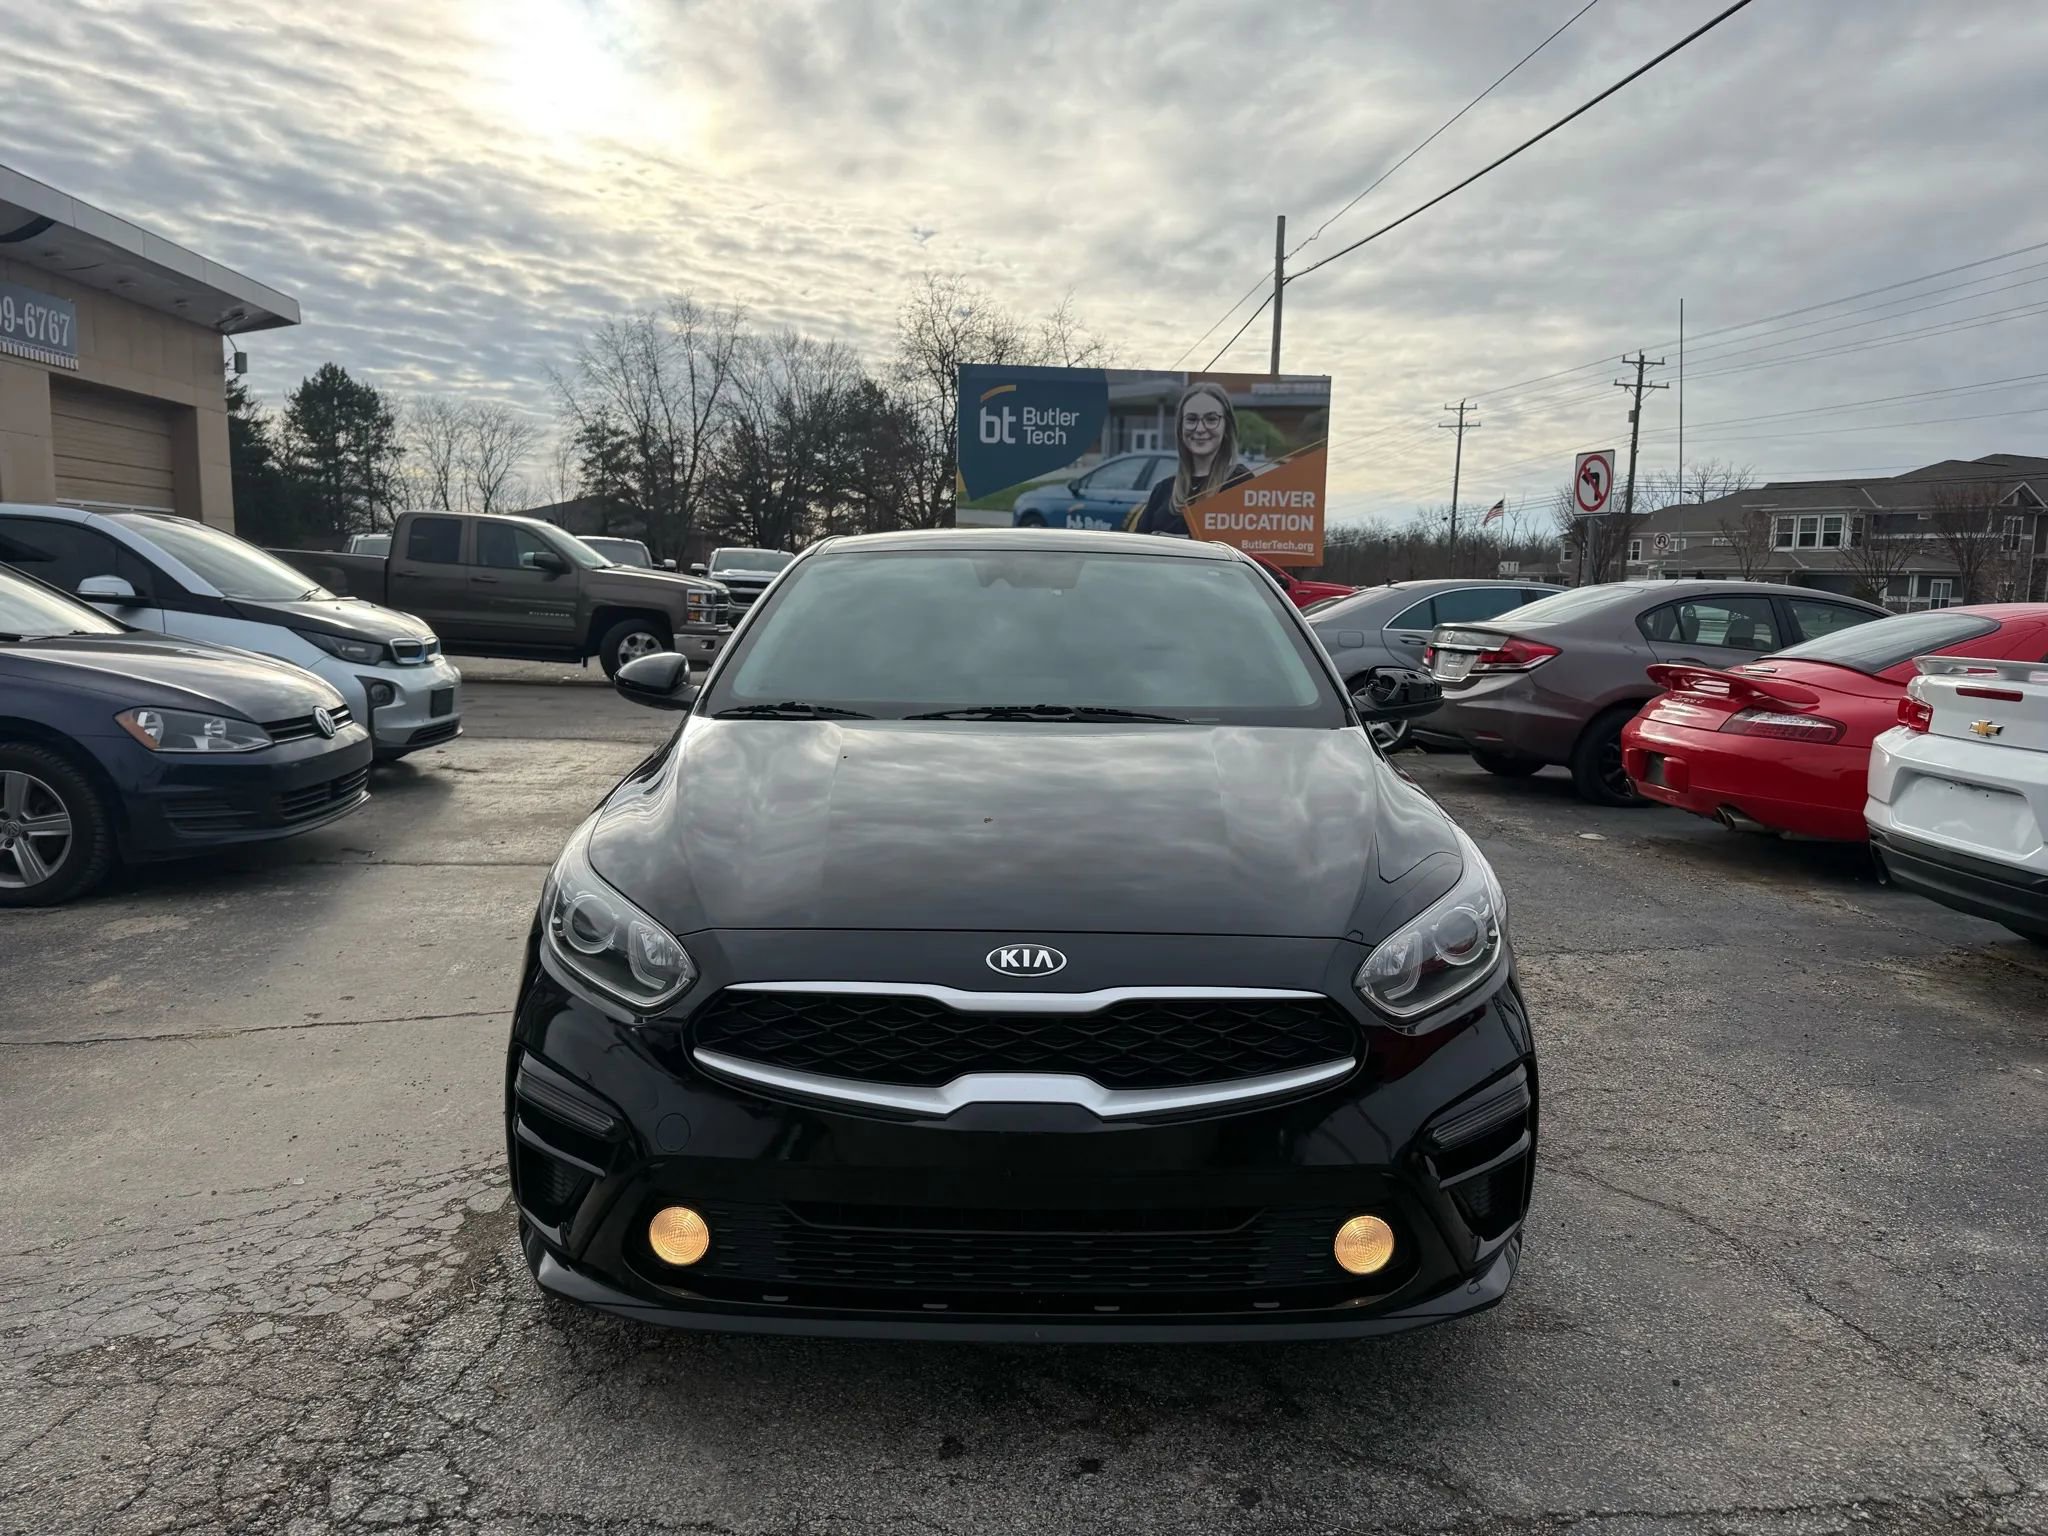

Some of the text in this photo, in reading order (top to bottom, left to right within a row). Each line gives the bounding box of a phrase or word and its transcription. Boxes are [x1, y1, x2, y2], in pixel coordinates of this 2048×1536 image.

[0, 295, 71, 347] 9-6767
[980, 406, 1017, 444] bt
[1023, 406, 1080, 426] Butler
[1022, 426, 1067, 445] Tech
[1243, 489, 1316, 508] DRIVER
[1204, 512, 1315, 532] EDUCATION
[1241, 540, 1315, 552] ButlerTech.org
[1000, 948, 1054, 968] KIA
